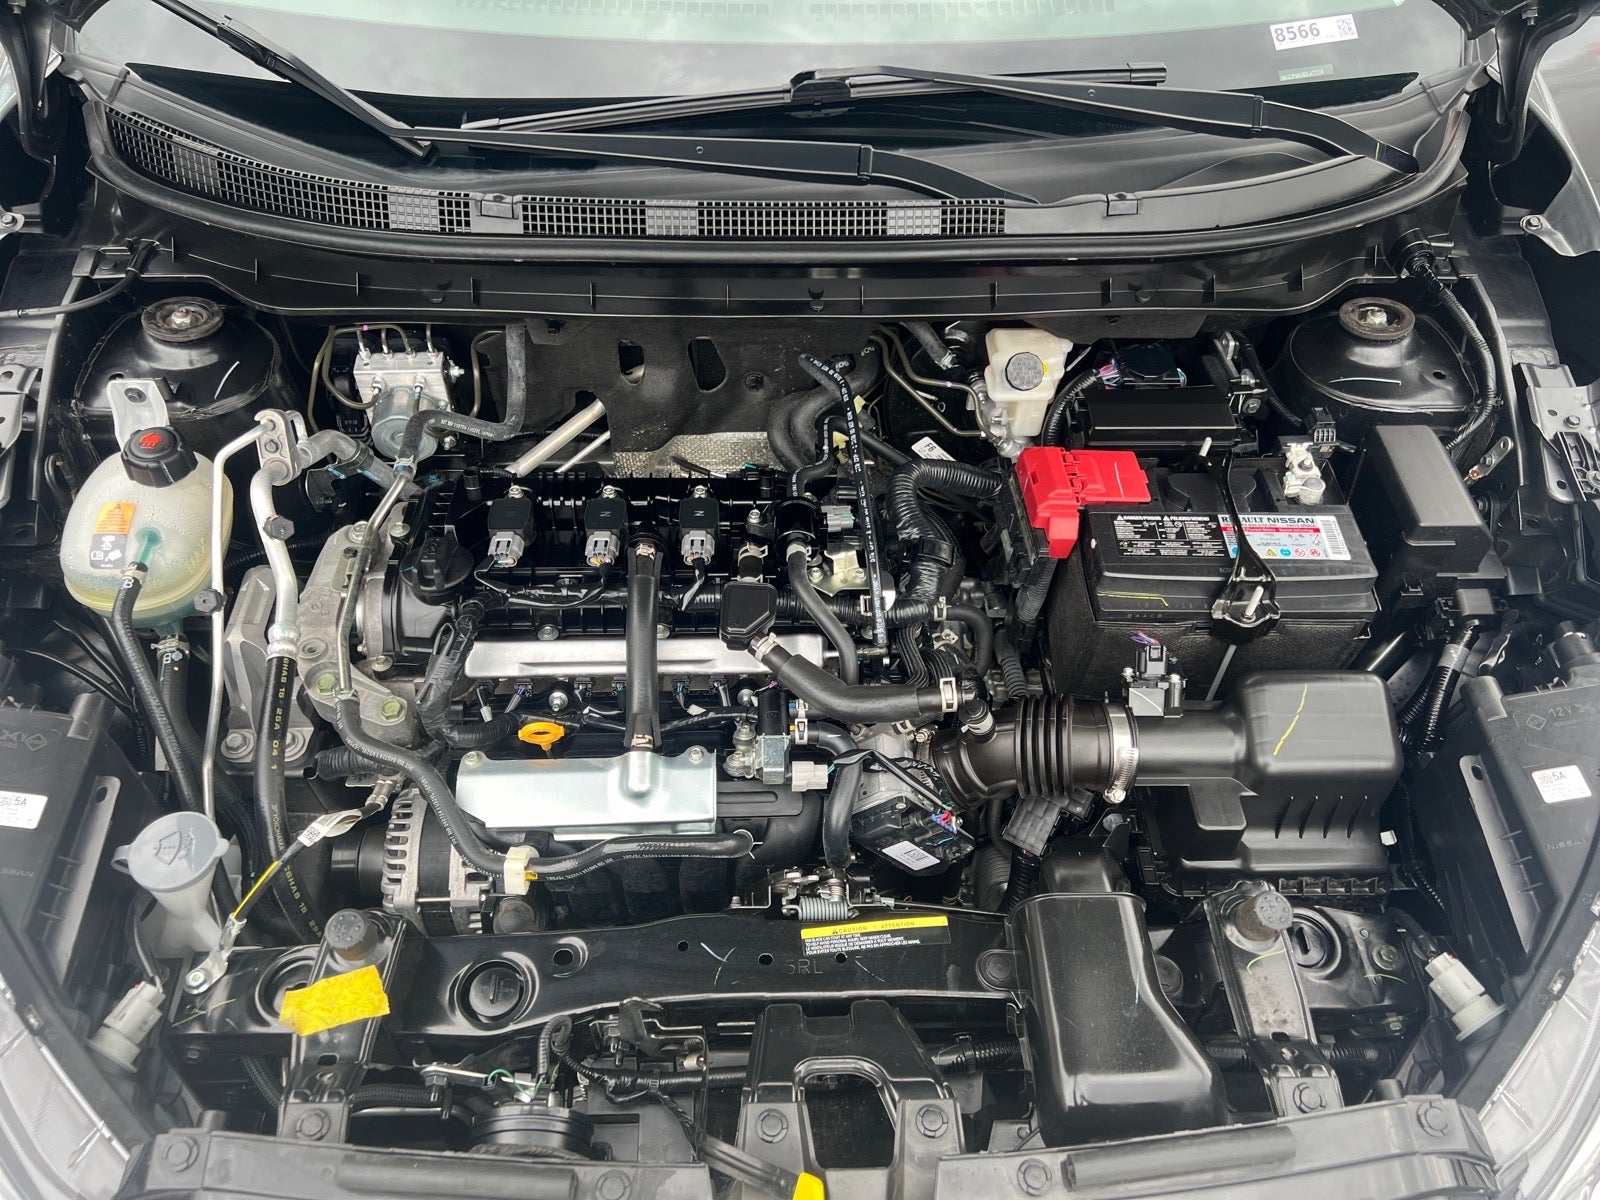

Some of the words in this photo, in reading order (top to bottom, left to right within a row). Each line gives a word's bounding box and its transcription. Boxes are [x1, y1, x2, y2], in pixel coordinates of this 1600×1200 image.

[1274, 23, 1320, 42] 8566
[924, 443, 936, 452] F6
[278, 688, 285, 698] 15
[274, 708, 282, 730] 25A
[1552, 772, 1566, 782] 5A
[14, 796, 27, 806] 5A
[272, 812, 286, 851] YOKOHAMA
[838, 926, 868, 934] CAUTION
[880, 922, 915, 930] ATTENTION
